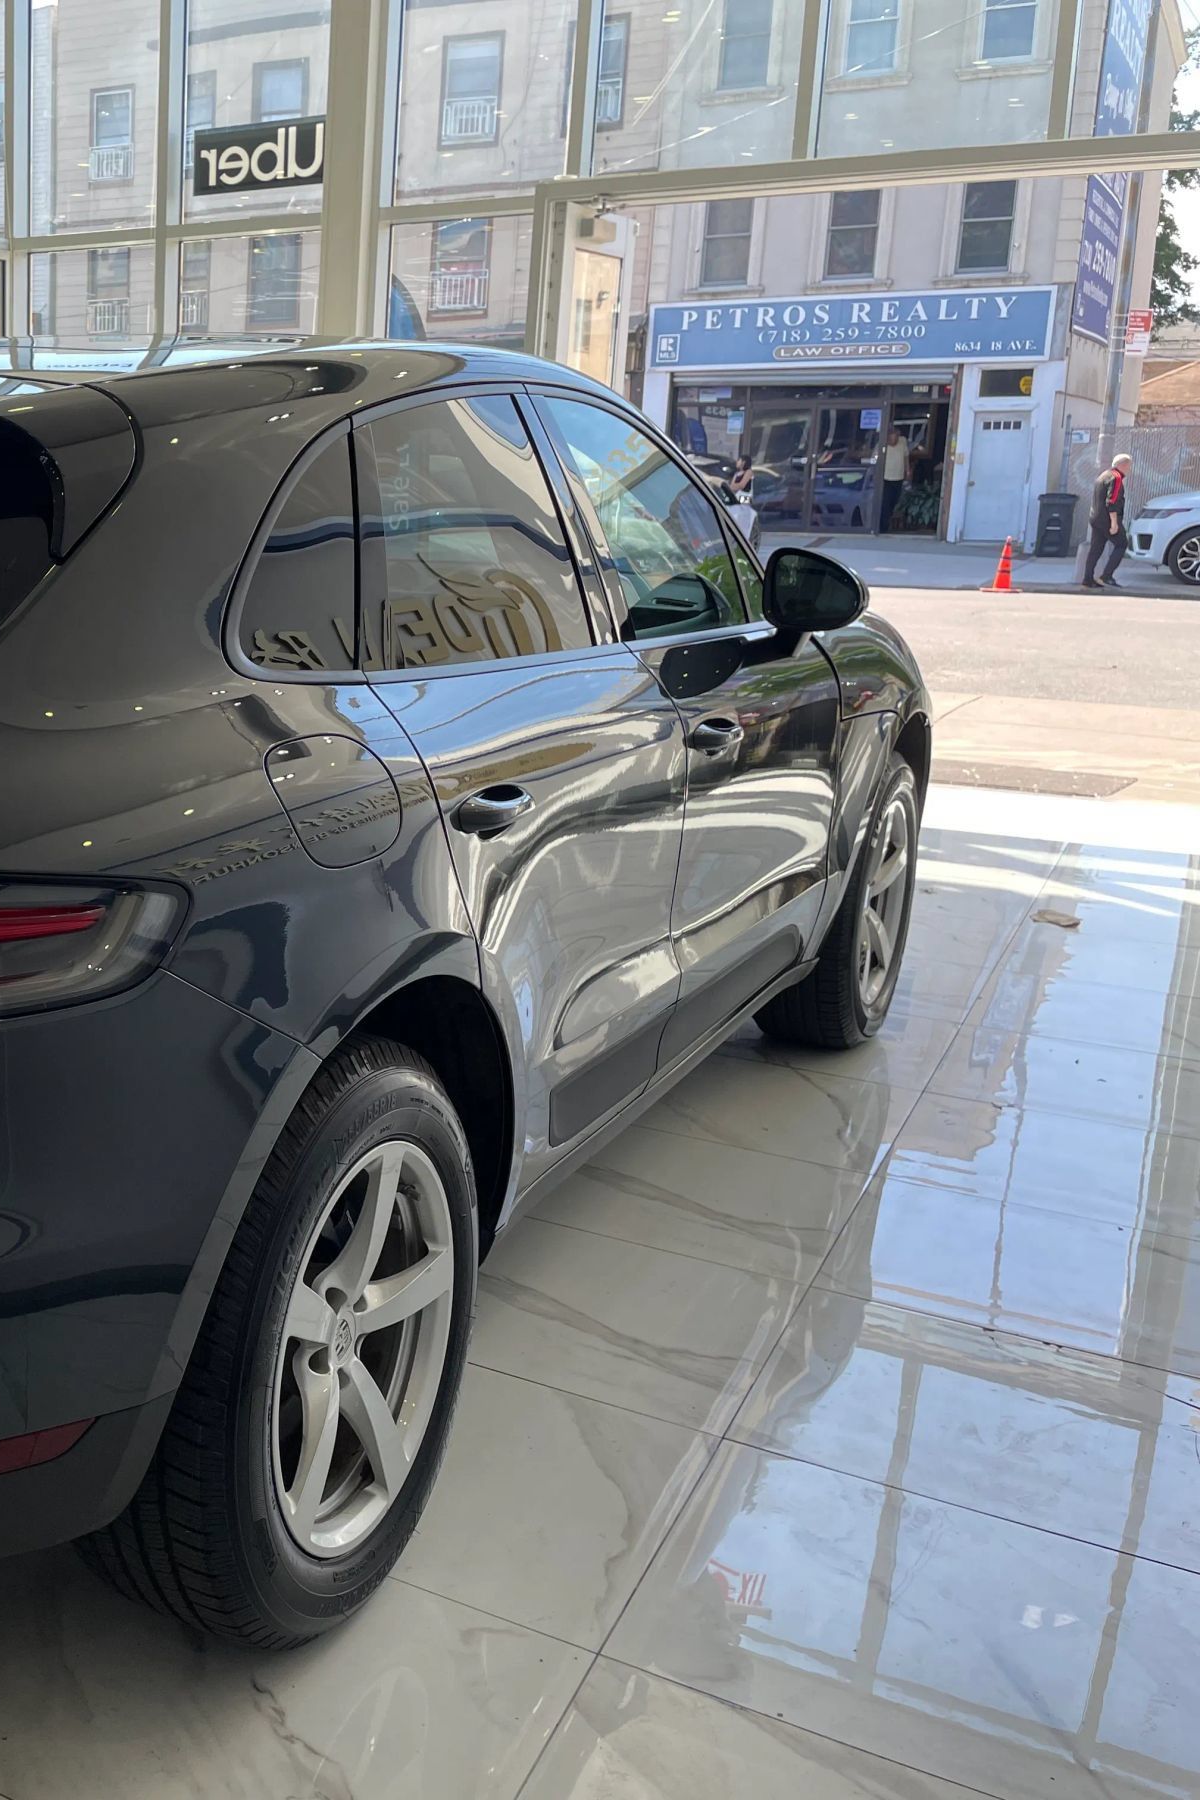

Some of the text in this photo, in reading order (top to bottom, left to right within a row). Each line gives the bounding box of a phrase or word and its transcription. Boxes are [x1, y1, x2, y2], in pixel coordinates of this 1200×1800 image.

[681, 296, 1018, 331] PETROS REALTY
[758, 325, 926, 344] (718) 259-7800
[780, 344, 904, 357] LAW OFFICE
[954, 341, 981, 352] 8634
[1007, 339, 1037, 351] AVE.
